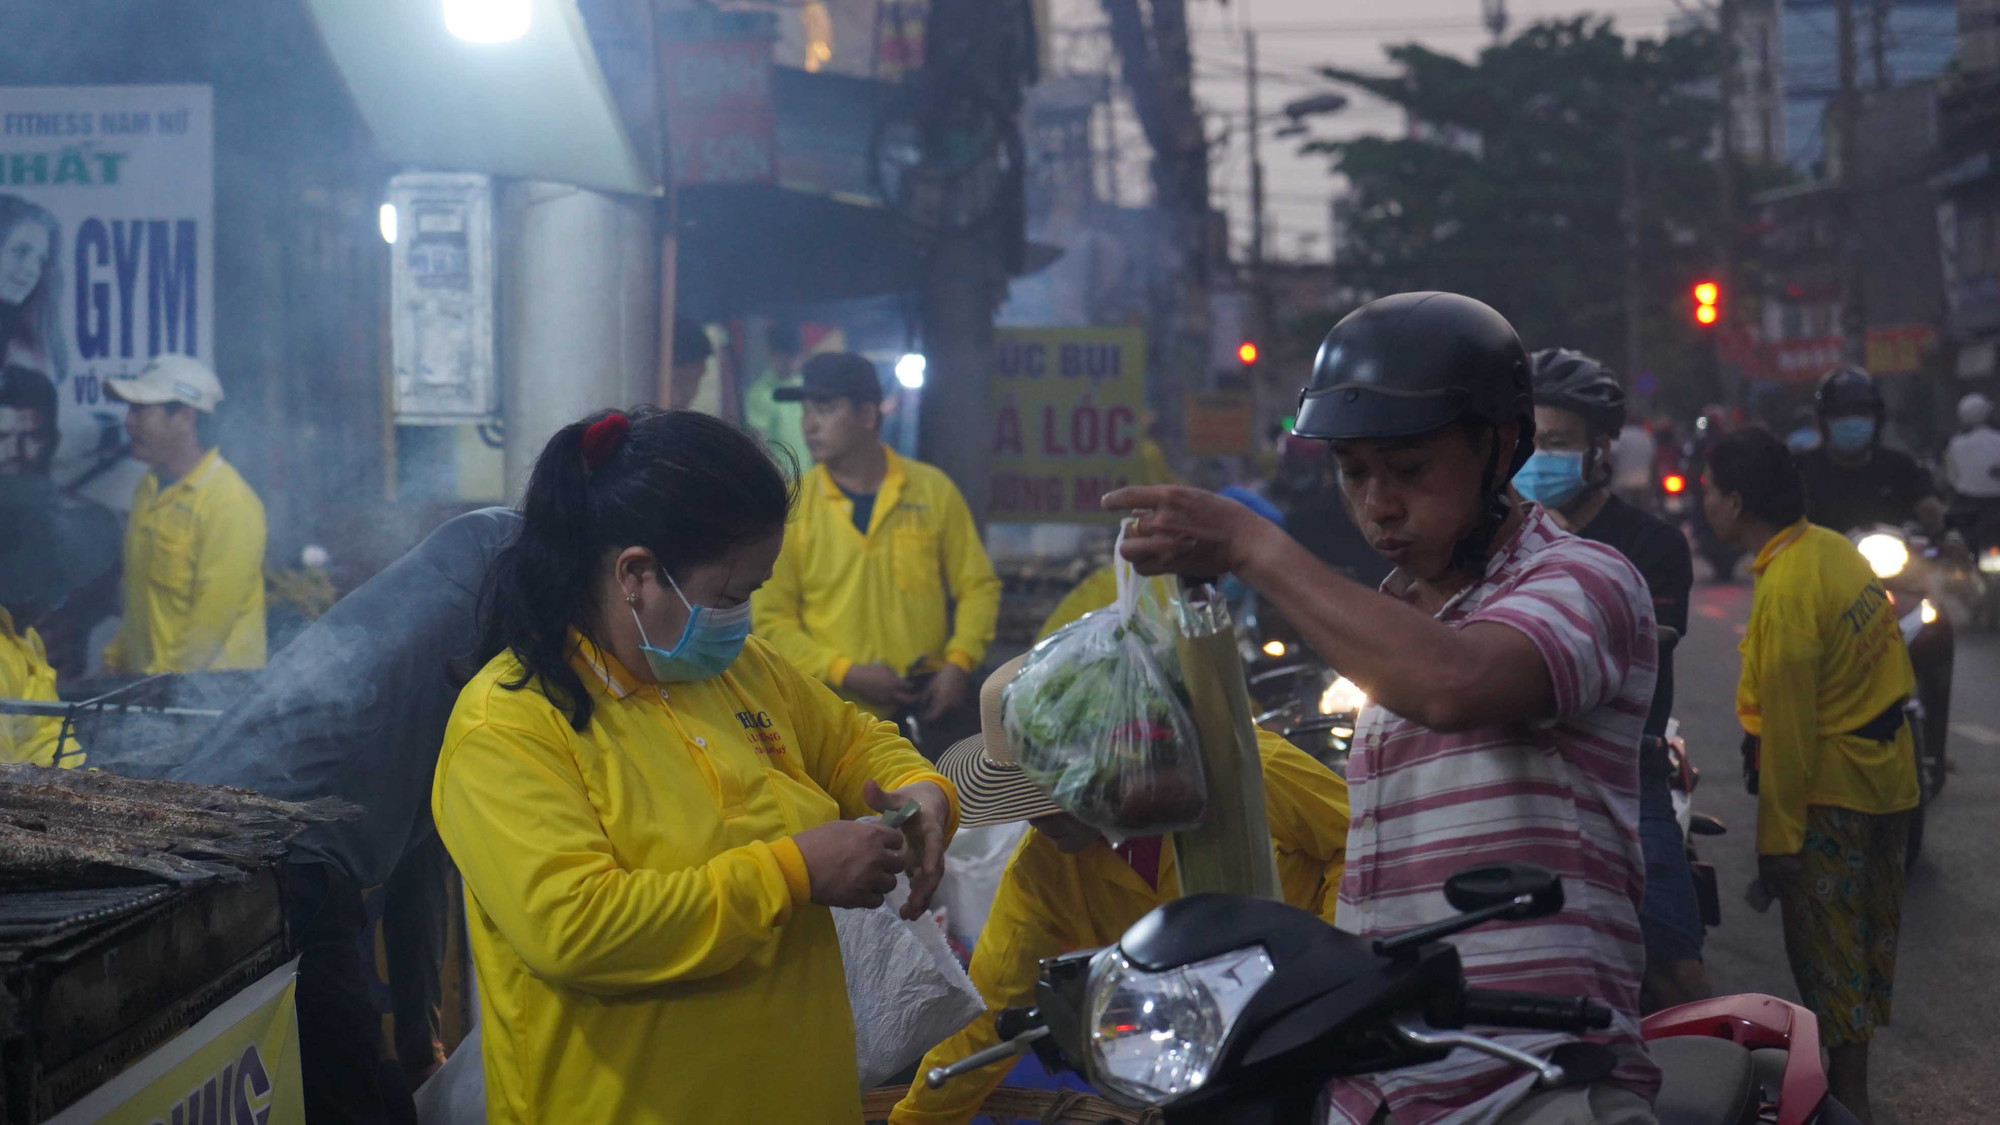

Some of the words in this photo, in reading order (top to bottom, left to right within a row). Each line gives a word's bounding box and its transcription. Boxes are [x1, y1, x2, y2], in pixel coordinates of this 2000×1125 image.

[5, 113, 94, 135] FITNESS
[100, 113, 151, 135] NAM
[0, 140, 129, 185] HẤT
[75, 216, 198, 360] GYM
